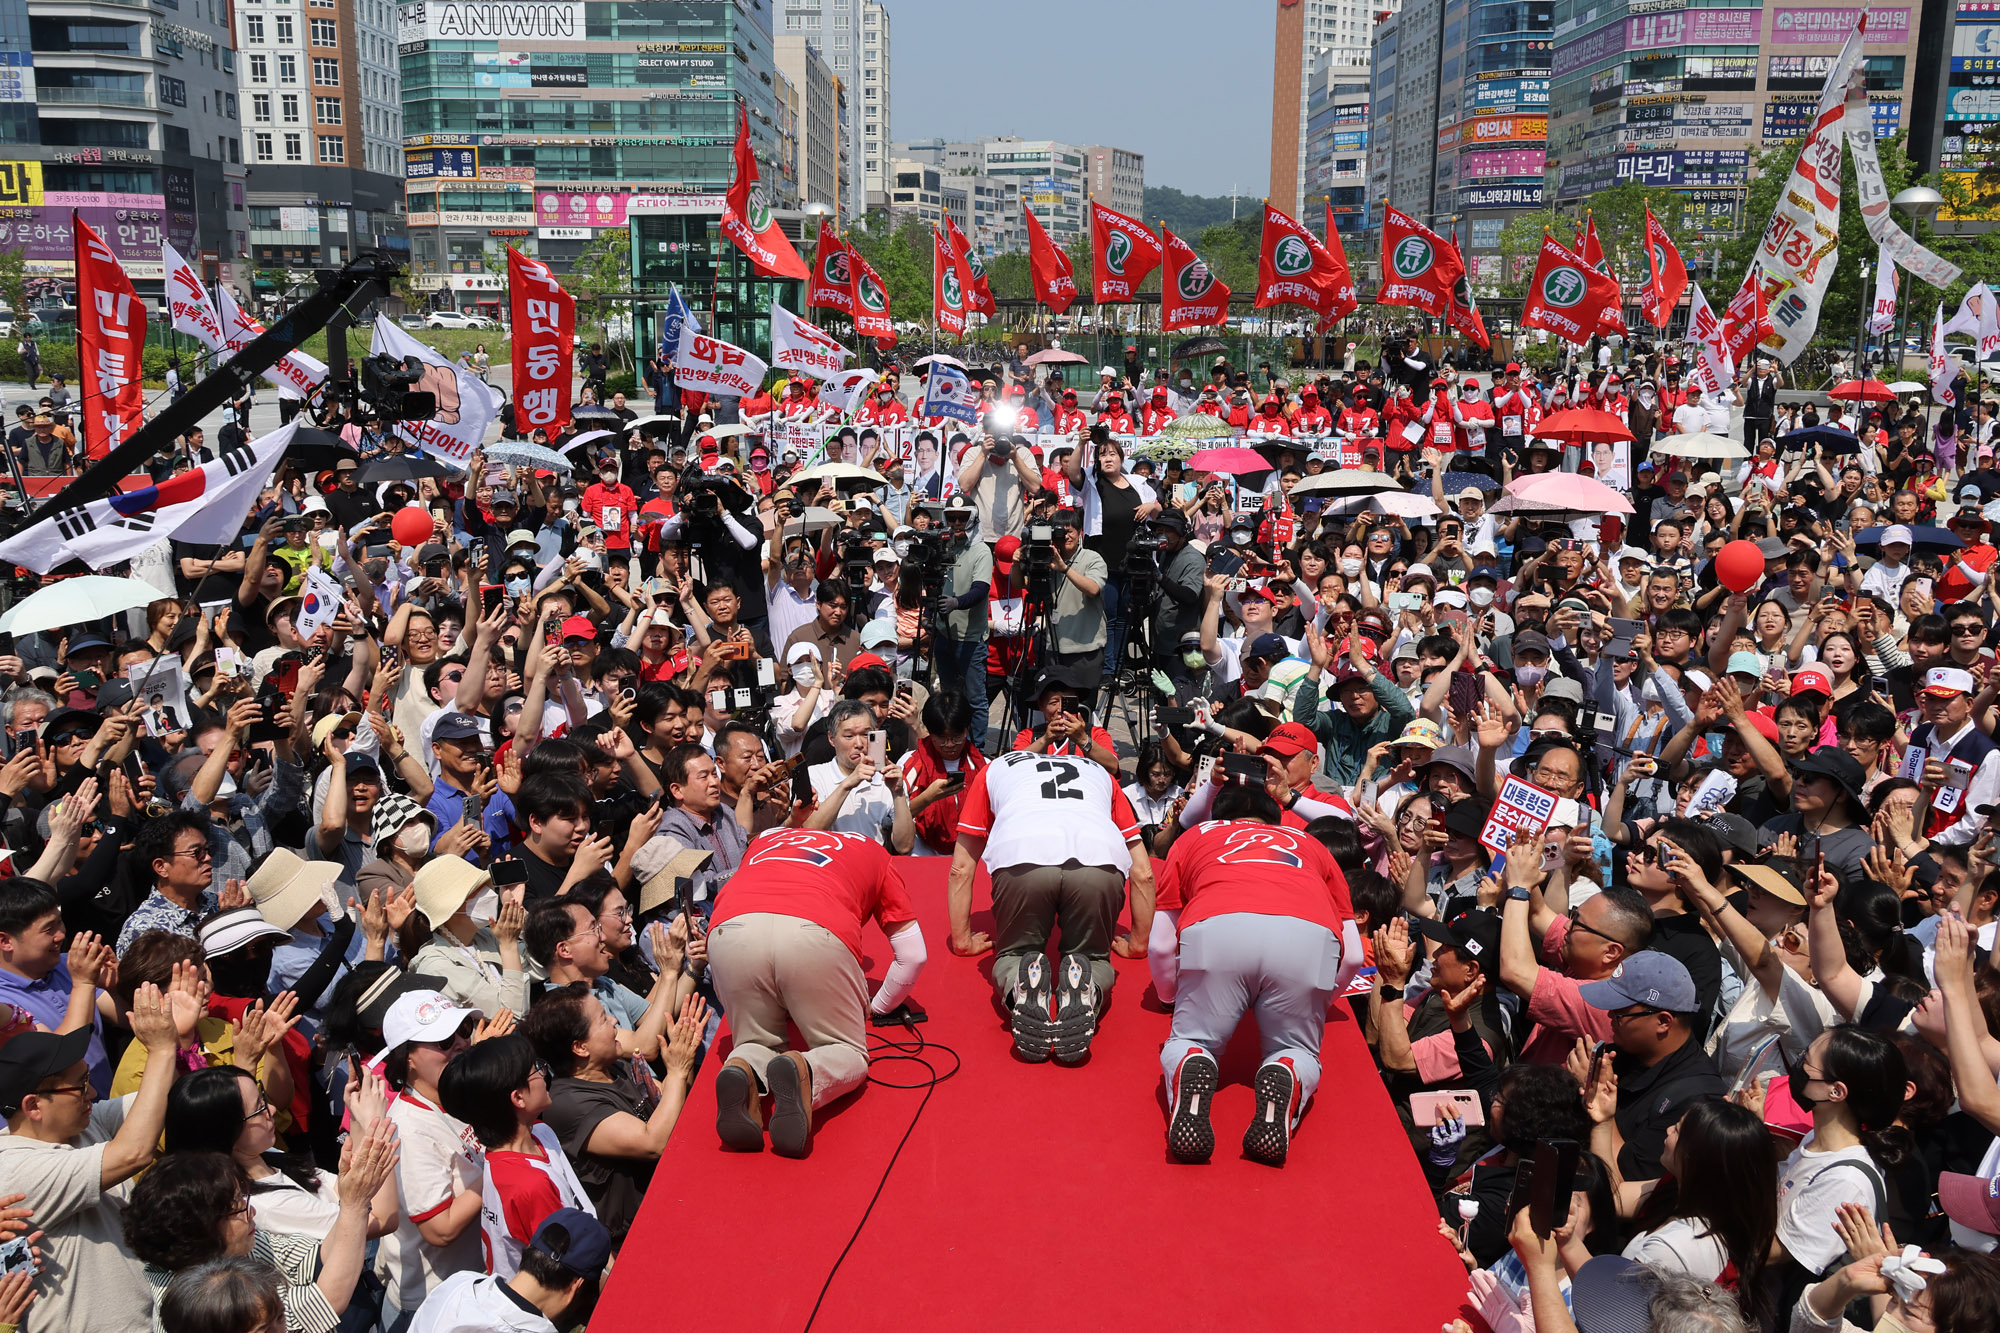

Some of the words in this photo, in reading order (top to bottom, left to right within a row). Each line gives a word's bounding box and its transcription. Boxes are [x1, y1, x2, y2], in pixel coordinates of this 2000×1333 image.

[439, 5, 574, 36] ANIWIN
[1698, 13, 1716, 23] 오전
[1718, 12, 1751, 23] 8시진료
[1794, 11, 1908, 30] 현대아산과의원
[1631, 13, 1687, 46] 내과
[1635, 107, 1672, 119] 2:20:18
[1477, 119, 1513, 138] 여의사
[1624, 128, 1642, 142] 치과
[1645, 127, 1674, 140] 전문의
[1616, 154, 1674, 183] 피부과
[66, 195, 101, 203] 515-0100
[1470, 189, 1512, 204] 비뇨의학과
[1512, 189, 1542, 203] 비뇨의
[130, 210, 160, 222] 은하수
[1684, 202, 1706, 216] 비염
[1710, 202, 1733, 216] 감기
[446, 215, 459, 223] 안과
[466, 215, 479, 223] 치과
[507, 215, 528, 223] 클리닉
[16, 224, 108, 244] 은하수과
[117, 224, 164, 247] 안과
[122, 249, 163, 258] 1566-7550
[1400, 240, 1424, 272] 육사
[1184, 264, 1210, 293] 육사
[1547, 273, 1578, 303] 육사
[862, 407, 870, 420] 2
[890, 412, 899, 425] 2
[1020, 414, 1029, 427] 2
[1163, 415, 1173, 427] 2
[1072, 417, 1082, 431] 2
[1119, 418, 1129, 433] 2
[902, 441, 912, 460] 2
[1320, 441, 1338, 450] 아내가
[943, 482, 954, 499] 2
[1003, 605, 1013, 621] 2
[145, 682, 168, 695] 김문수
[162, 718, 172, 730] 2
[1270, 729, 1298, 741] tleist
[1035, 761, 1084, 801] 2
[1503, 783, 1552, 818] 대통령은
[1485, 824, 1497, 840] 2
